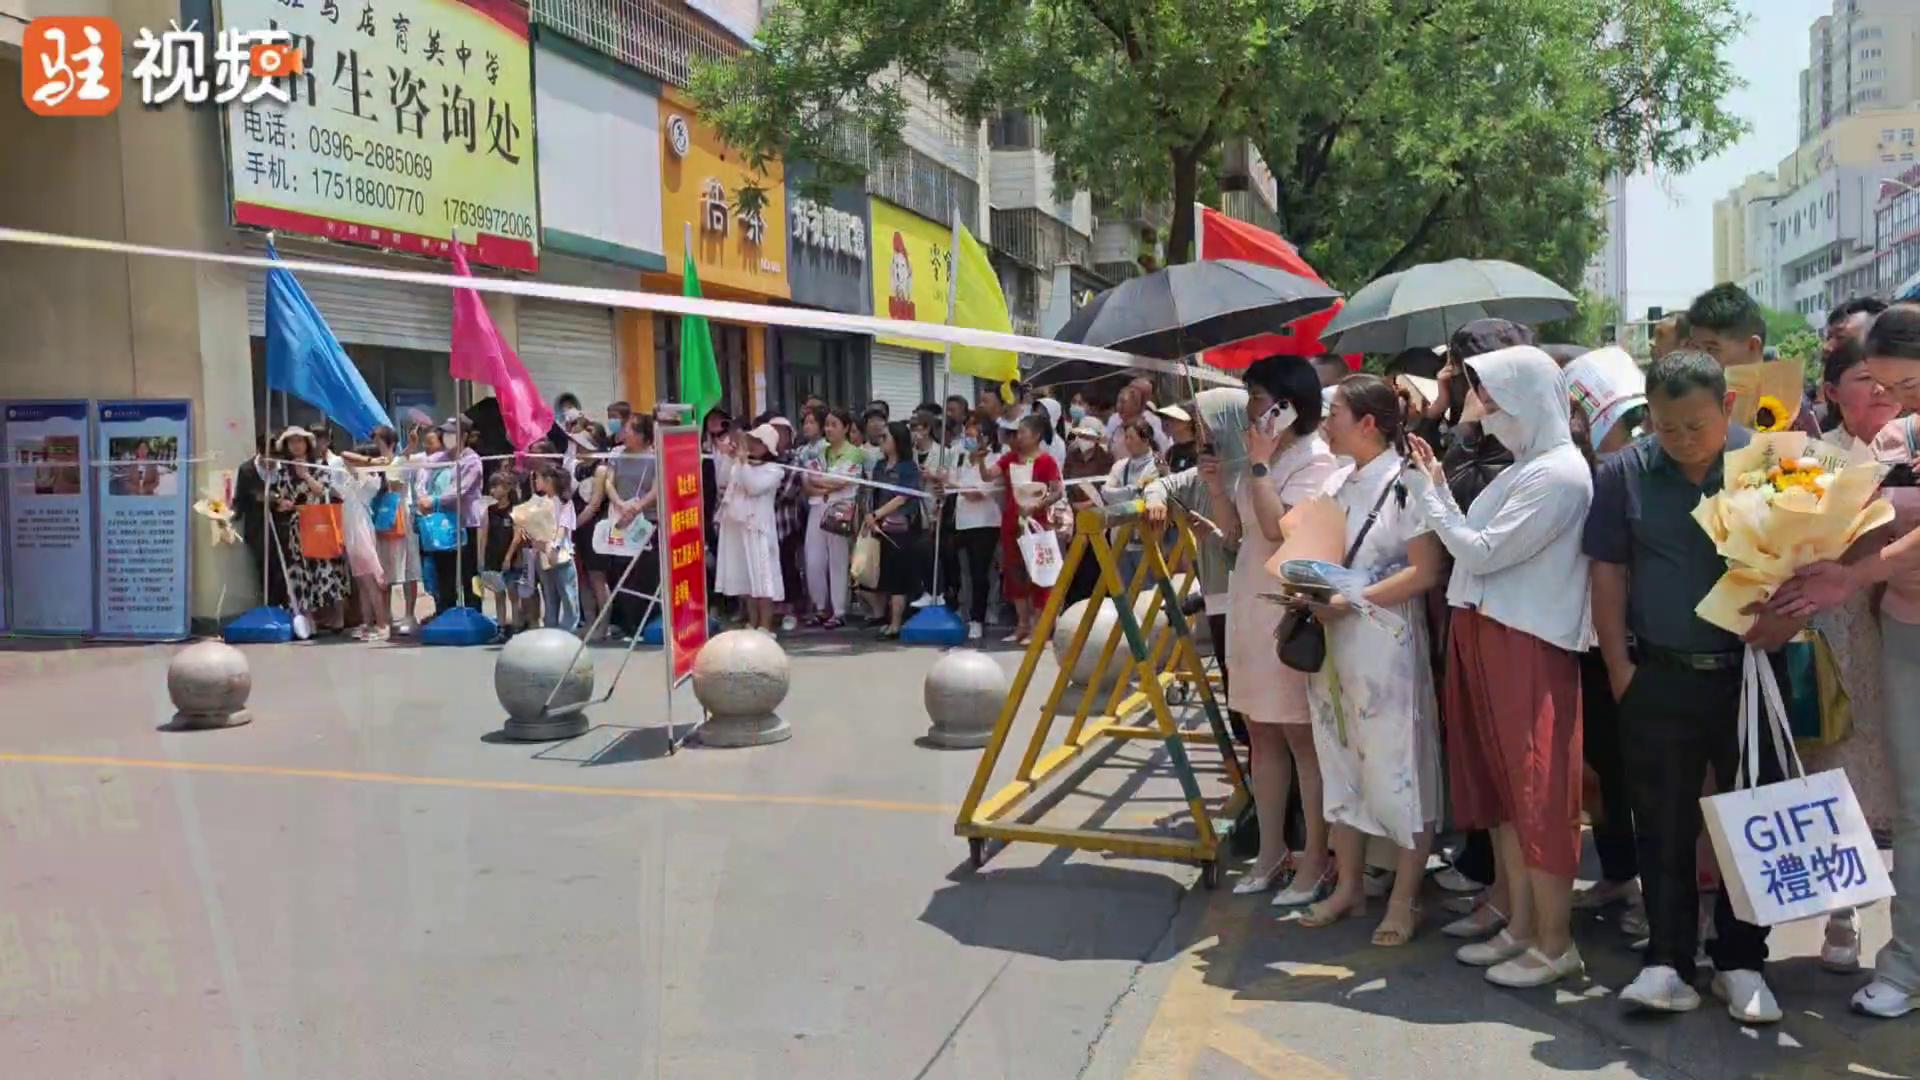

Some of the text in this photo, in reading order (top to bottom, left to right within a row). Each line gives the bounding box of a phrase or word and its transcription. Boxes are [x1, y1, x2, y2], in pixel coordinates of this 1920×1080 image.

[277, 0, 499, 85] 马店育英中学
[1744, 796, 1841, 853] GIFT
[1759, 842, 1868, 906] 禮物
